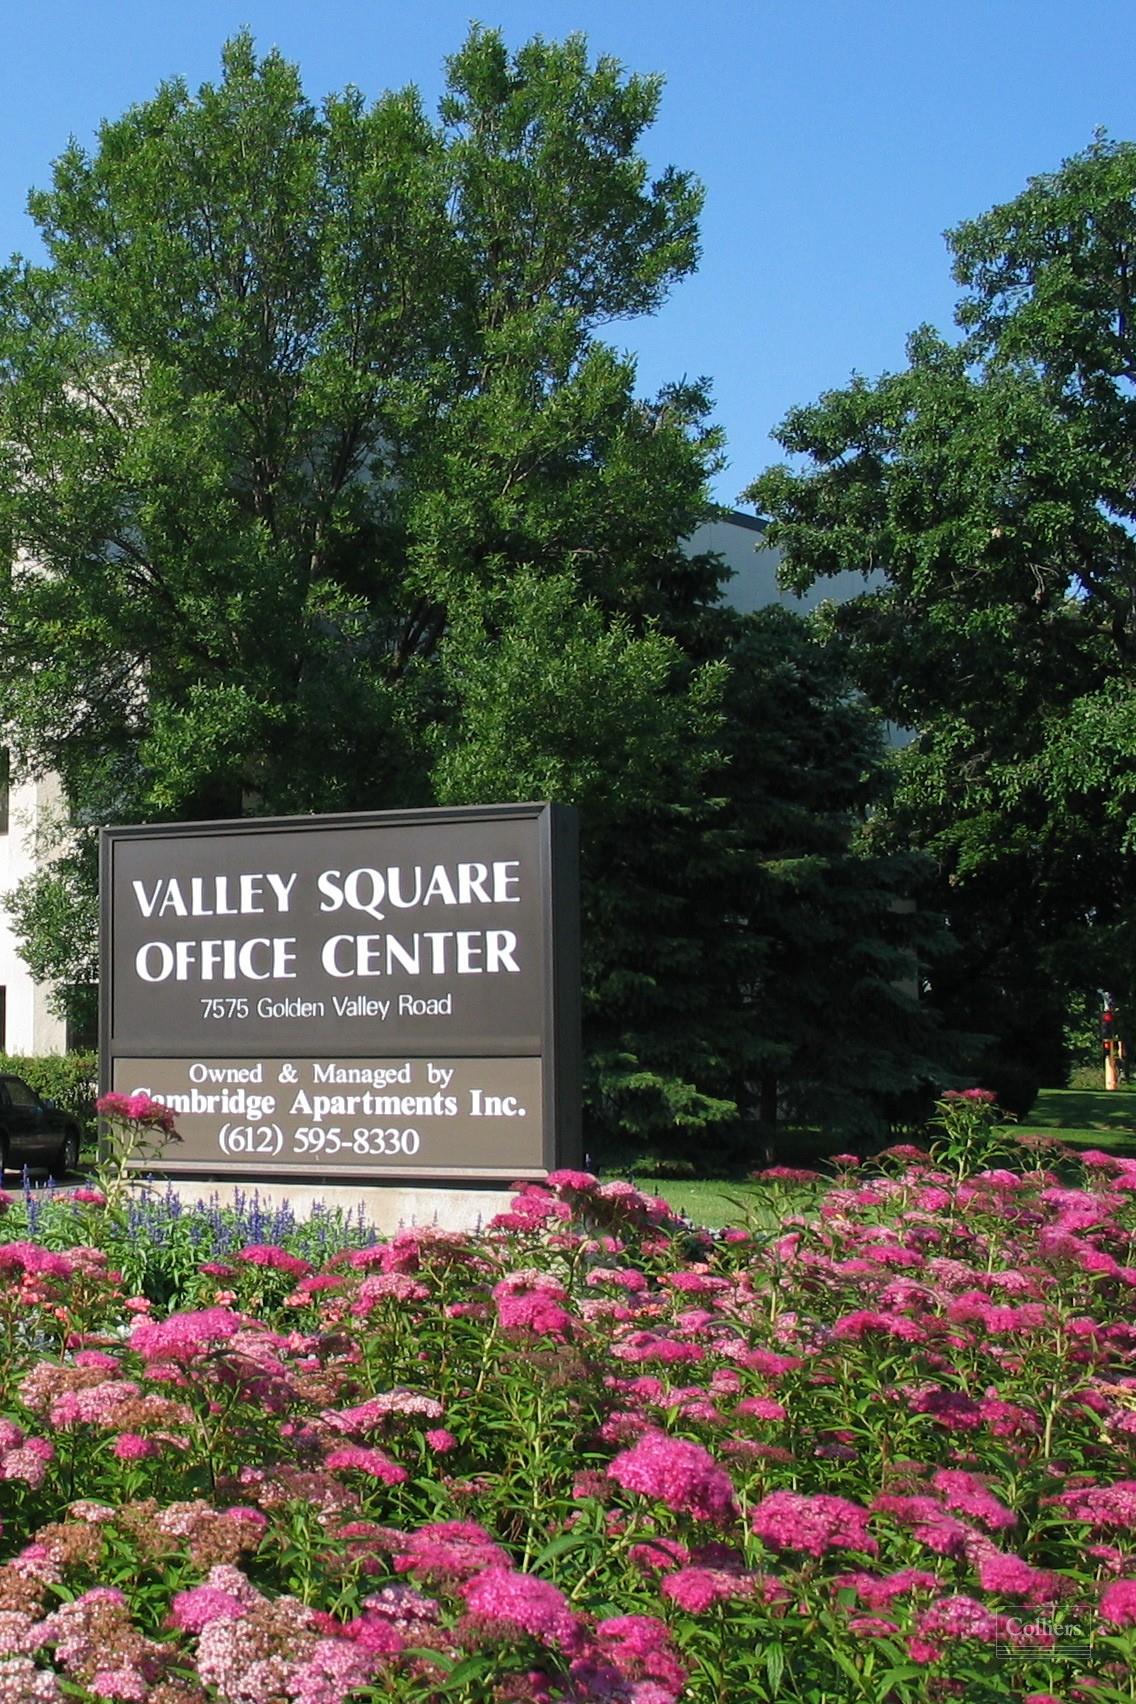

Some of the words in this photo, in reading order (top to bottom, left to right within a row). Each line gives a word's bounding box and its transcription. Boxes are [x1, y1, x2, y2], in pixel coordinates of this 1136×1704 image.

[132, 872, 298, 918] VALLEY
[317, 860, 521, 921] SQUARE
[135, 937, 297, 983] OFFICE
[321, 929, 521, 978] CENTER
[200, 998, 249, 1019] 7575
[257, 997, 325, 1018] Golden
[332, 995, 391, 1021] Valley
[398, 993, 452, 1016] Road
[188, 1062, 264, 1084] Owned
[277, 1063, 299, 1084] &
[311, 1062, 412, 1089] Managed
[426, 1062, 455, 1087] by
[289, 1089, 459, 1121] Apartments
[468, 1088, 527, 1117] Inc.
[218, 1122, 284, 1157] (612)
[292, 1126, 421, 1155] 595-8330
